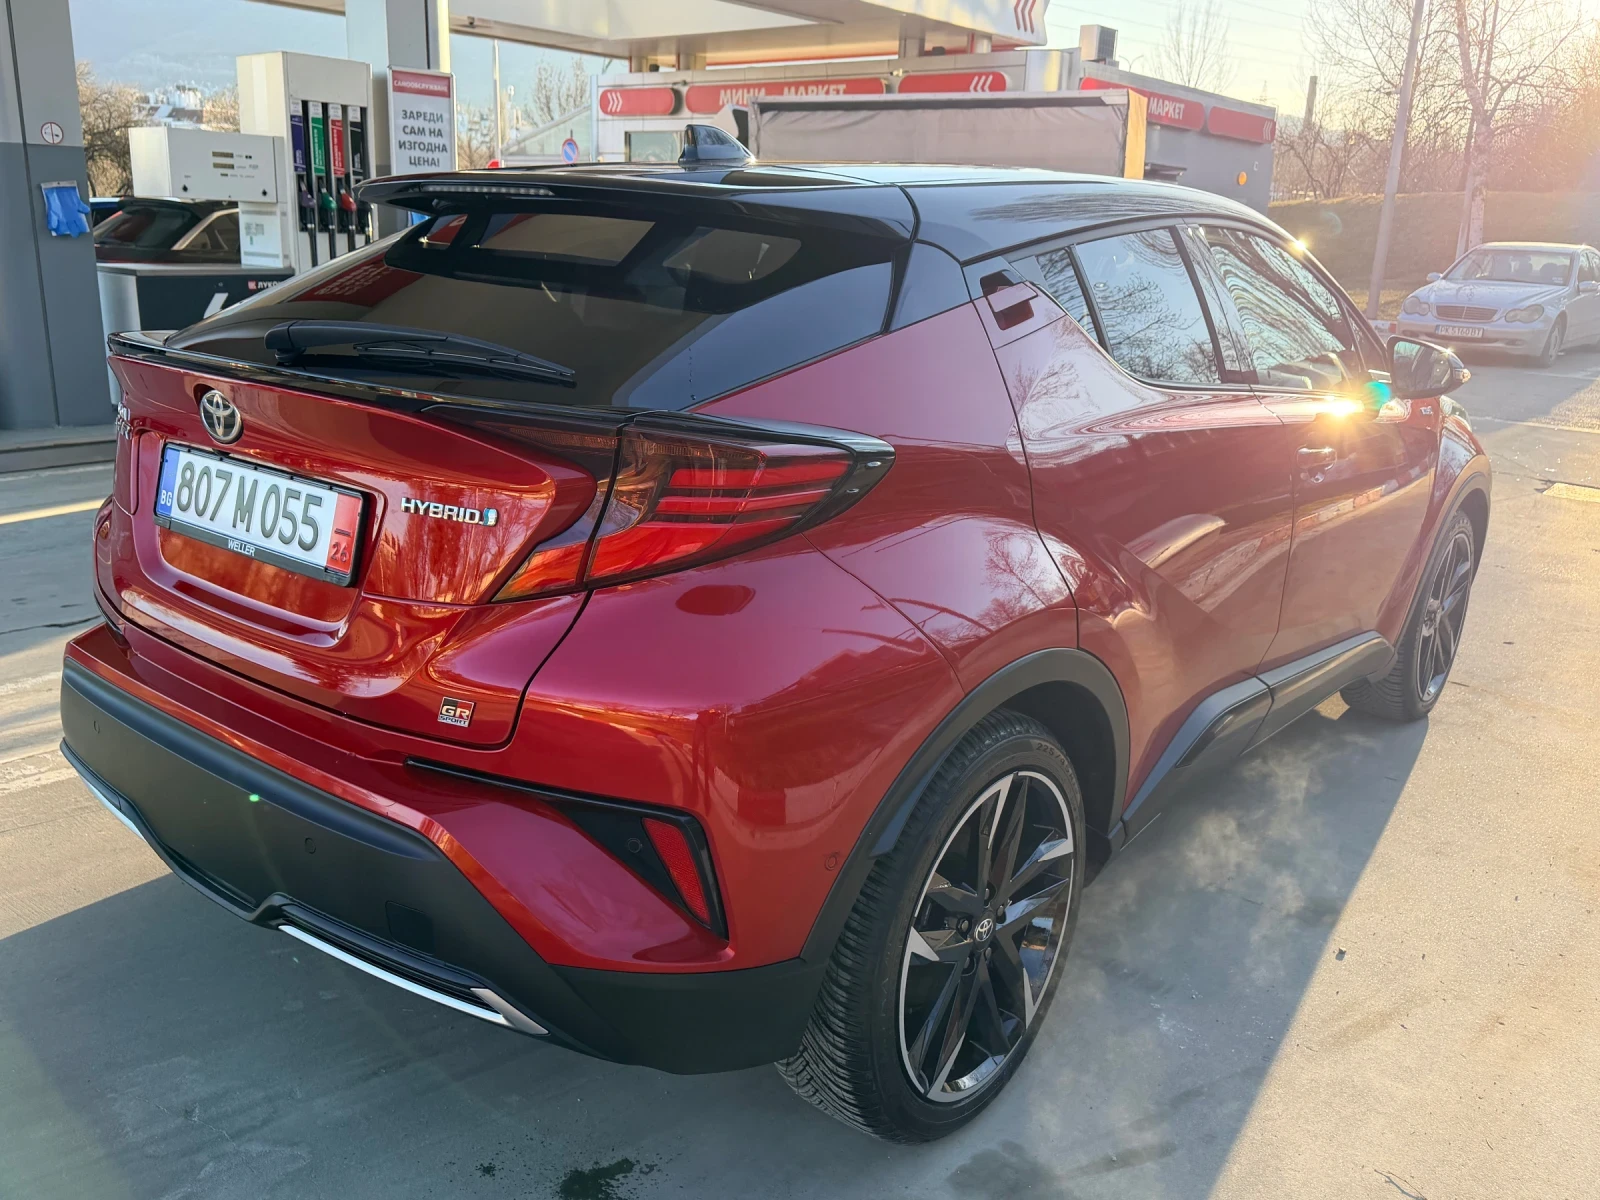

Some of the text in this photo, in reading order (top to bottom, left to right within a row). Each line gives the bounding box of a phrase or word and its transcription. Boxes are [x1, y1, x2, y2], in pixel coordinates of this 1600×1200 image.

[401, 109, 444, 124] ЗАРЕДИ
[1149, 97, 1185, 120] МАРКЕТ
[402, 125, 443, 139] САМ НА
[398, 140, 448, 154] ИЗГОДНА
[409, 155, 440, 168] ЦЕНА!
[160, 489, 173, 507] BG
[176, 461, 323, 552] 807 M 055
[401, 497, 481, 525] HYBRID
[228, 538, 256, 557] WELLER
[331, 541, 351, 563] 26
[440, 715, 467, 725] SPORT
[441, 705, 470, 720] GR
